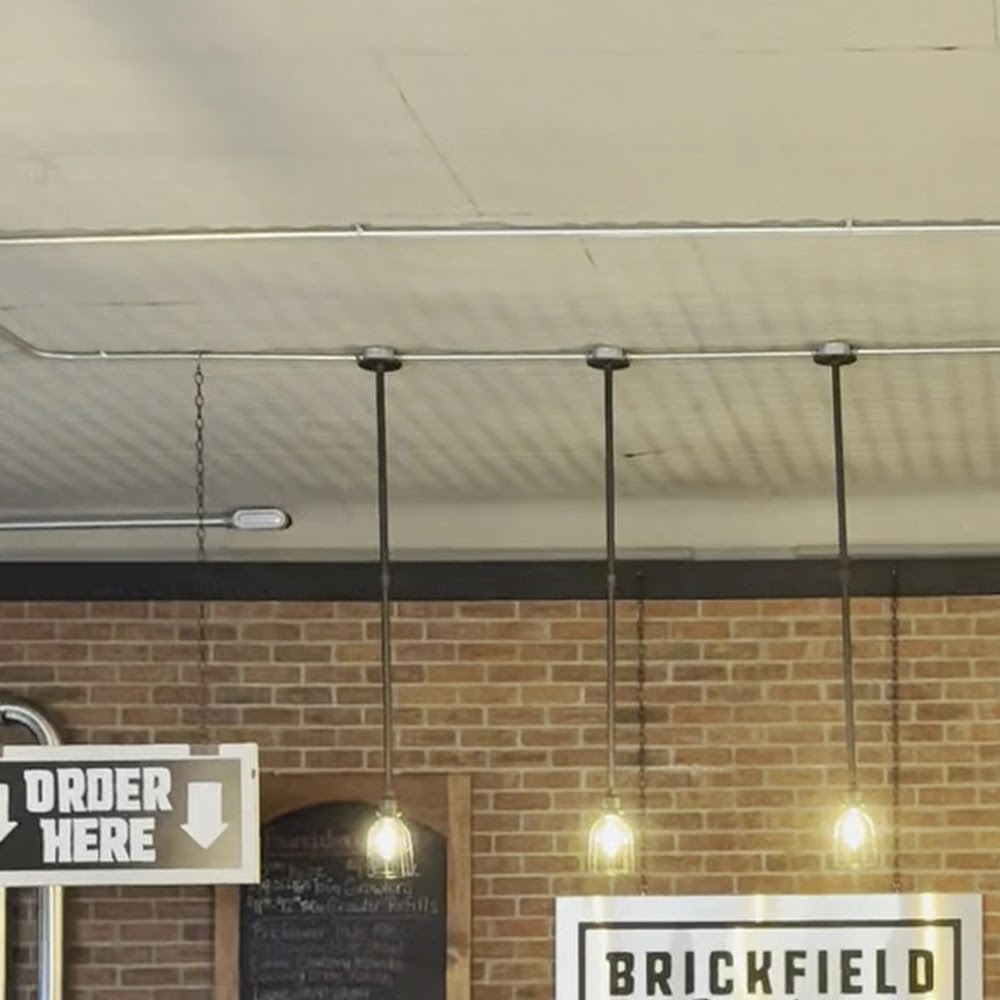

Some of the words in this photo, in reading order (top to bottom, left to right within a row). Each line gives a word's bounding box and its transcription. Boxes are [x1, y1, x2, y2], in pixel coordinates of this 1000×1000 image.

[23, 767, 173, 814] ORDER
[40, 817, 157, 863] HERE
[605, 948, 936, 997] BRICKFIELD
